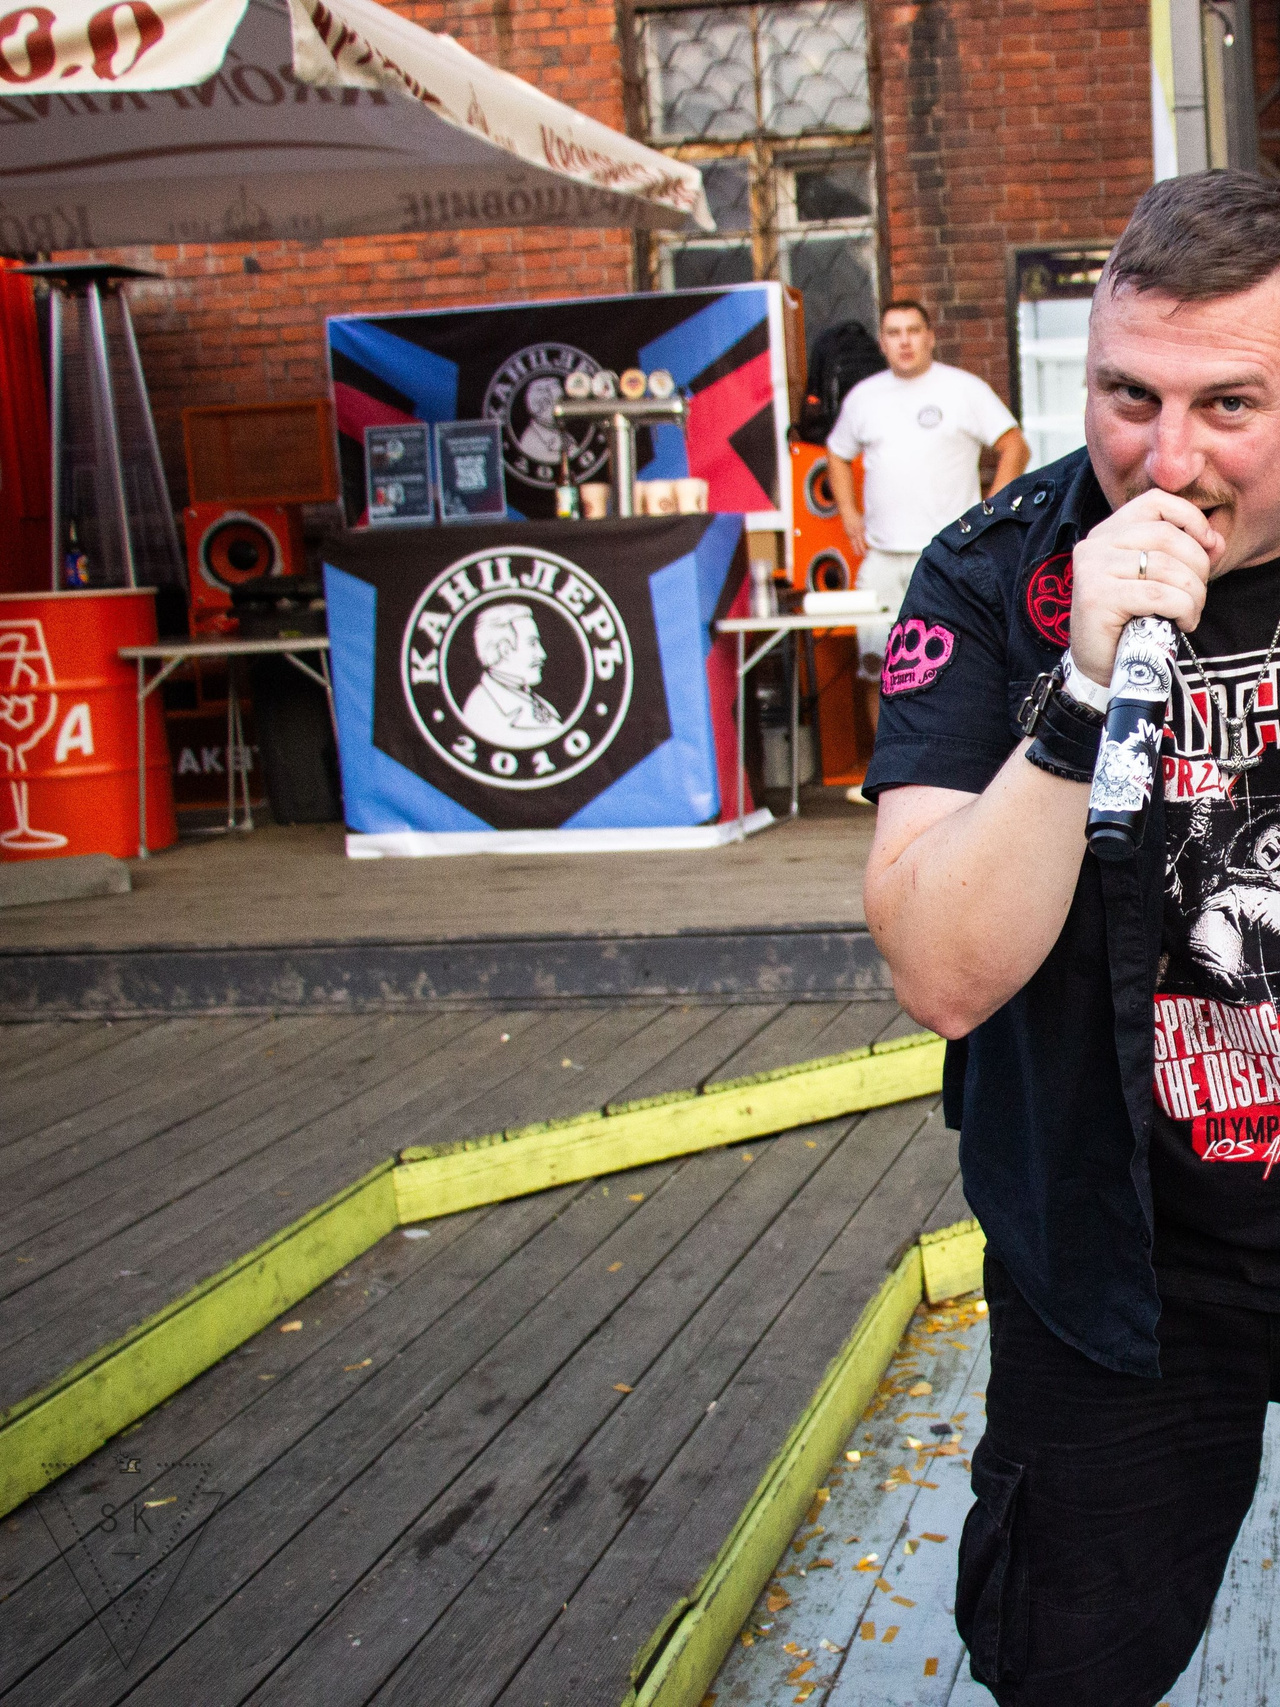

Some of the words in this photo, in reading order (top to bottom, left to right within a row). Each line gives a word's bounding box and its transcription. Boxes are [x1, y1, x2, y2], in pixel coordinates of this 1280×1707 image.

[514, 449, 596, 480] 200
[411, 557, 623, 685] КАНЦЛЕРЪ
[452, 729, 591, 776] 2010
[1154, 1057, 1206, 1118] THE
[1203, 1138, 1254, 1160] LOS
